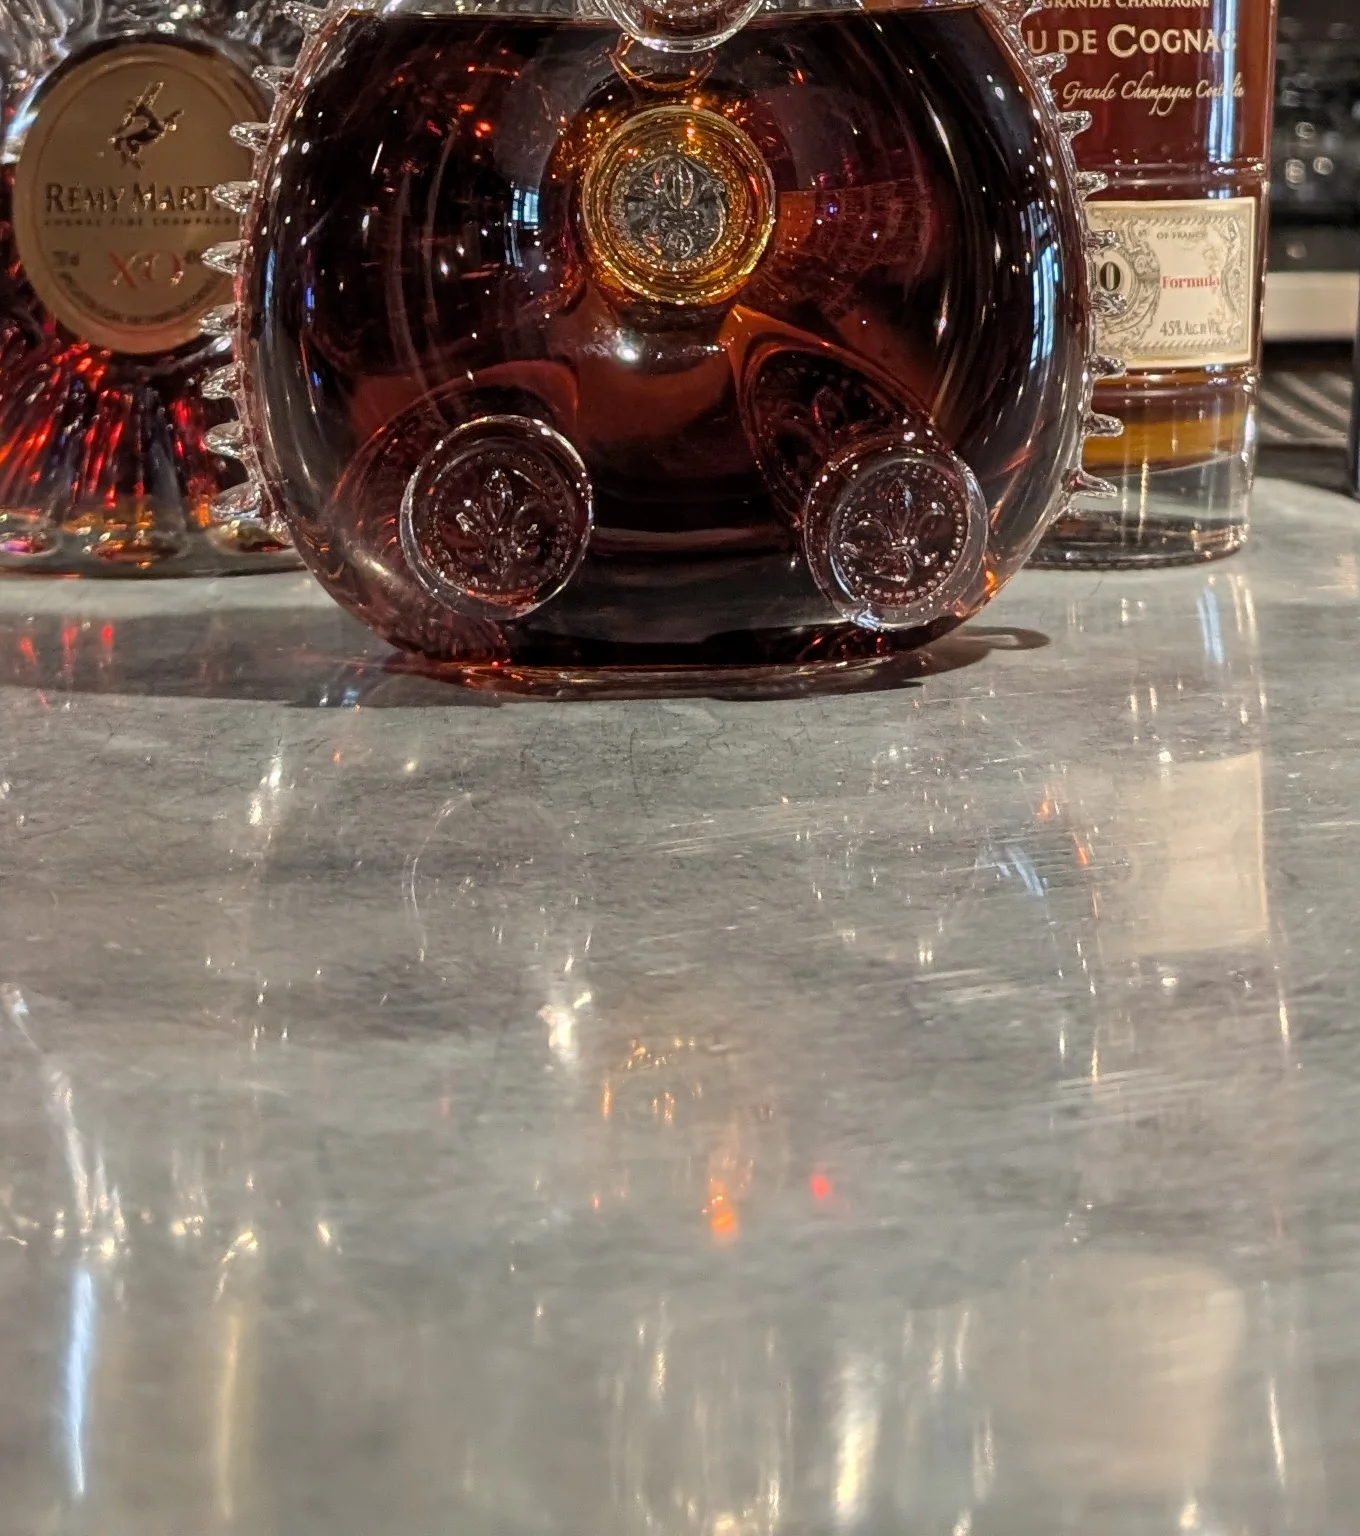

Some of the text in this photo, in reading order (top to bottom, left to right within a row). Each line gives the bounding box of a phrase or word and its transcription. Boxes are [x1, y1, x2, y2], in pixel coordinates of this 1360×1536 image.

[1057, 29, 1098, 55] DE
[1107, 23, 1237, 59] COGNAC
[1062, 72, 1122, 108] Grande
[1120, 70, 1193, 116] Champagne
[108, 250, 185, 289] XO
